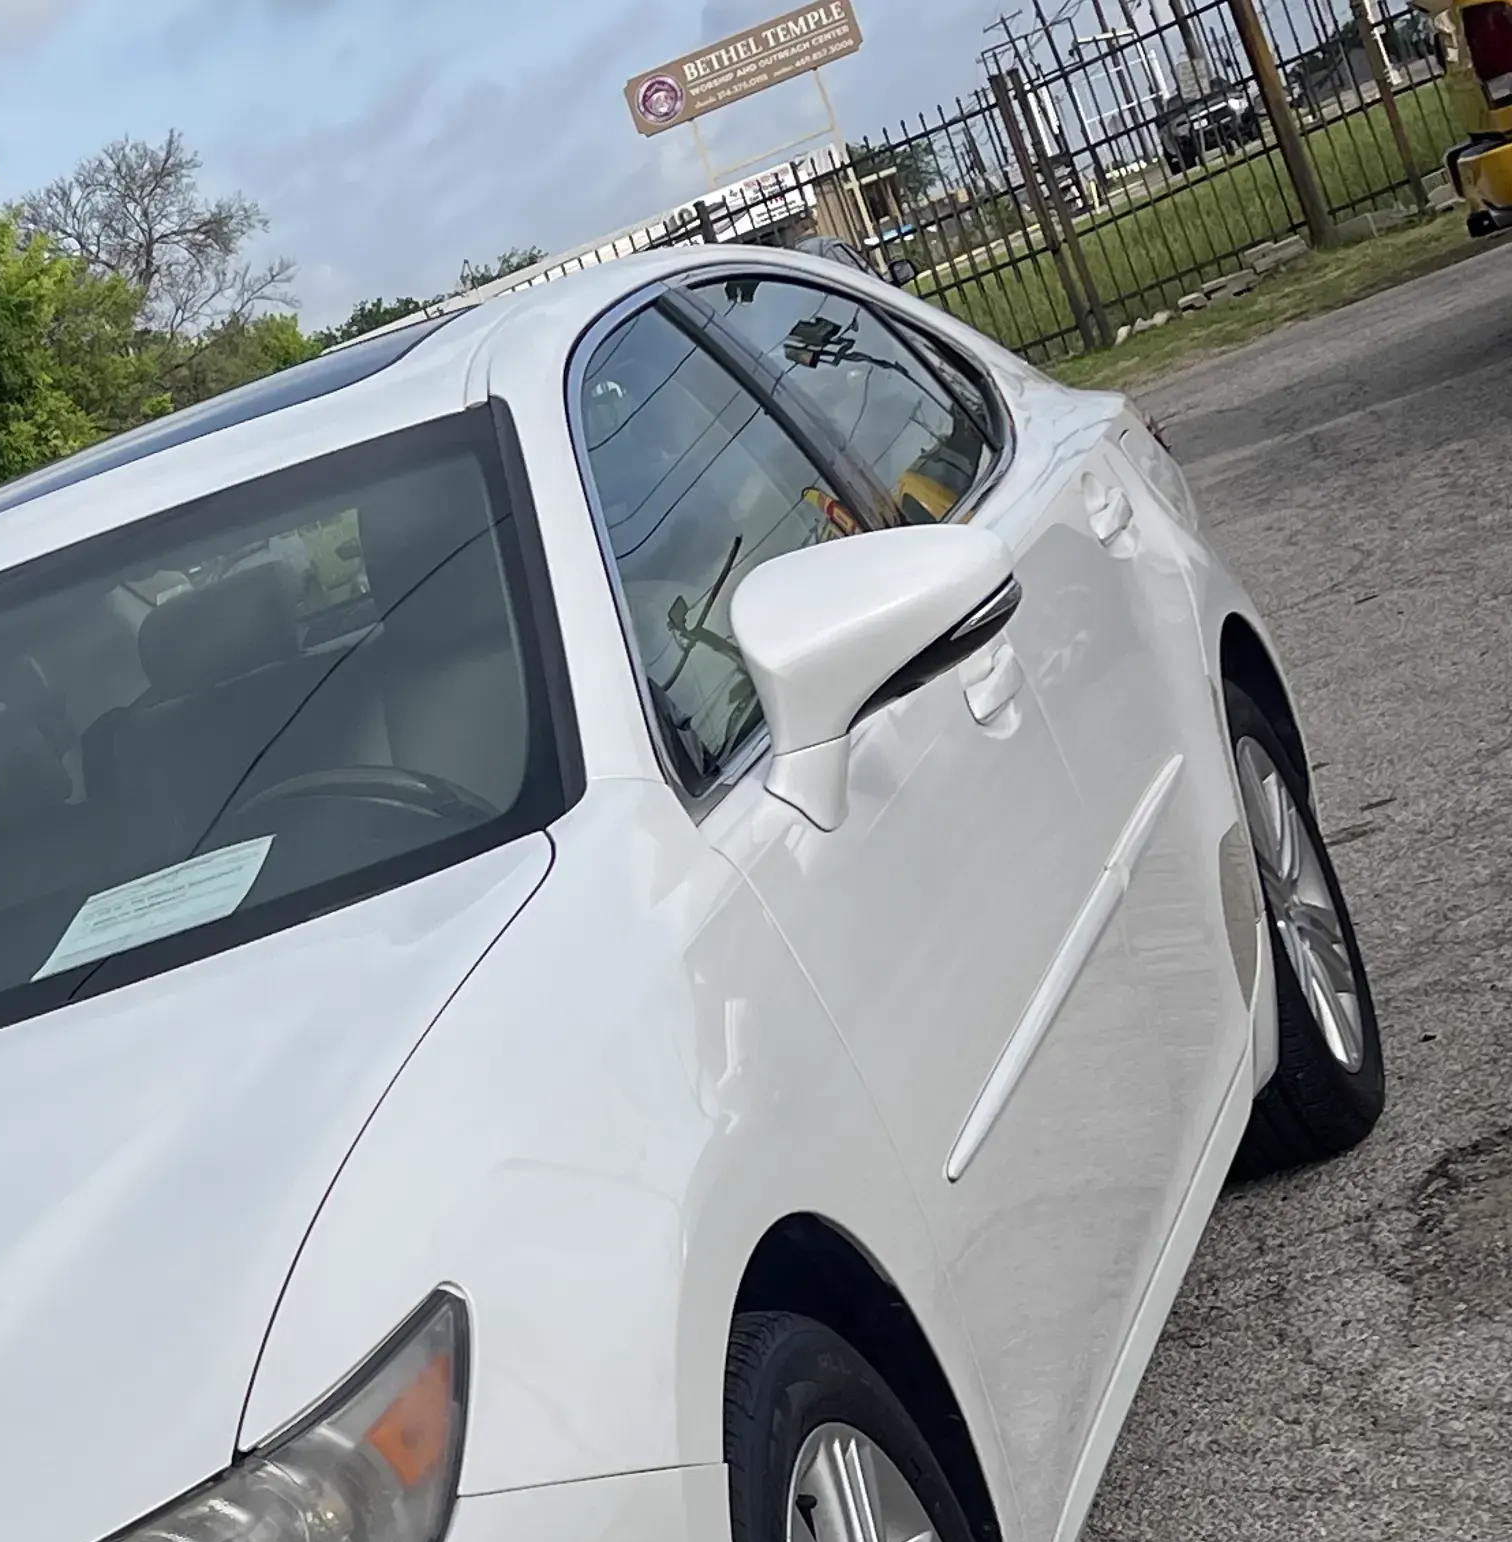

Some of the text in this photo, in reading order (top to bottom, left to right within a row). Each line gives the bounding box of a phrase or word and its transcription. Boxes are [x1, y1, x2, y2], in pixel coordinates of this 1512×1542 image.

[682, 1, 846, 80] BETHEL TEMPLE
[736, 63, 758, 77] AND
[758, 42, 810, 68] OUTREACH
[811, 25, 850, 46] CENTER
